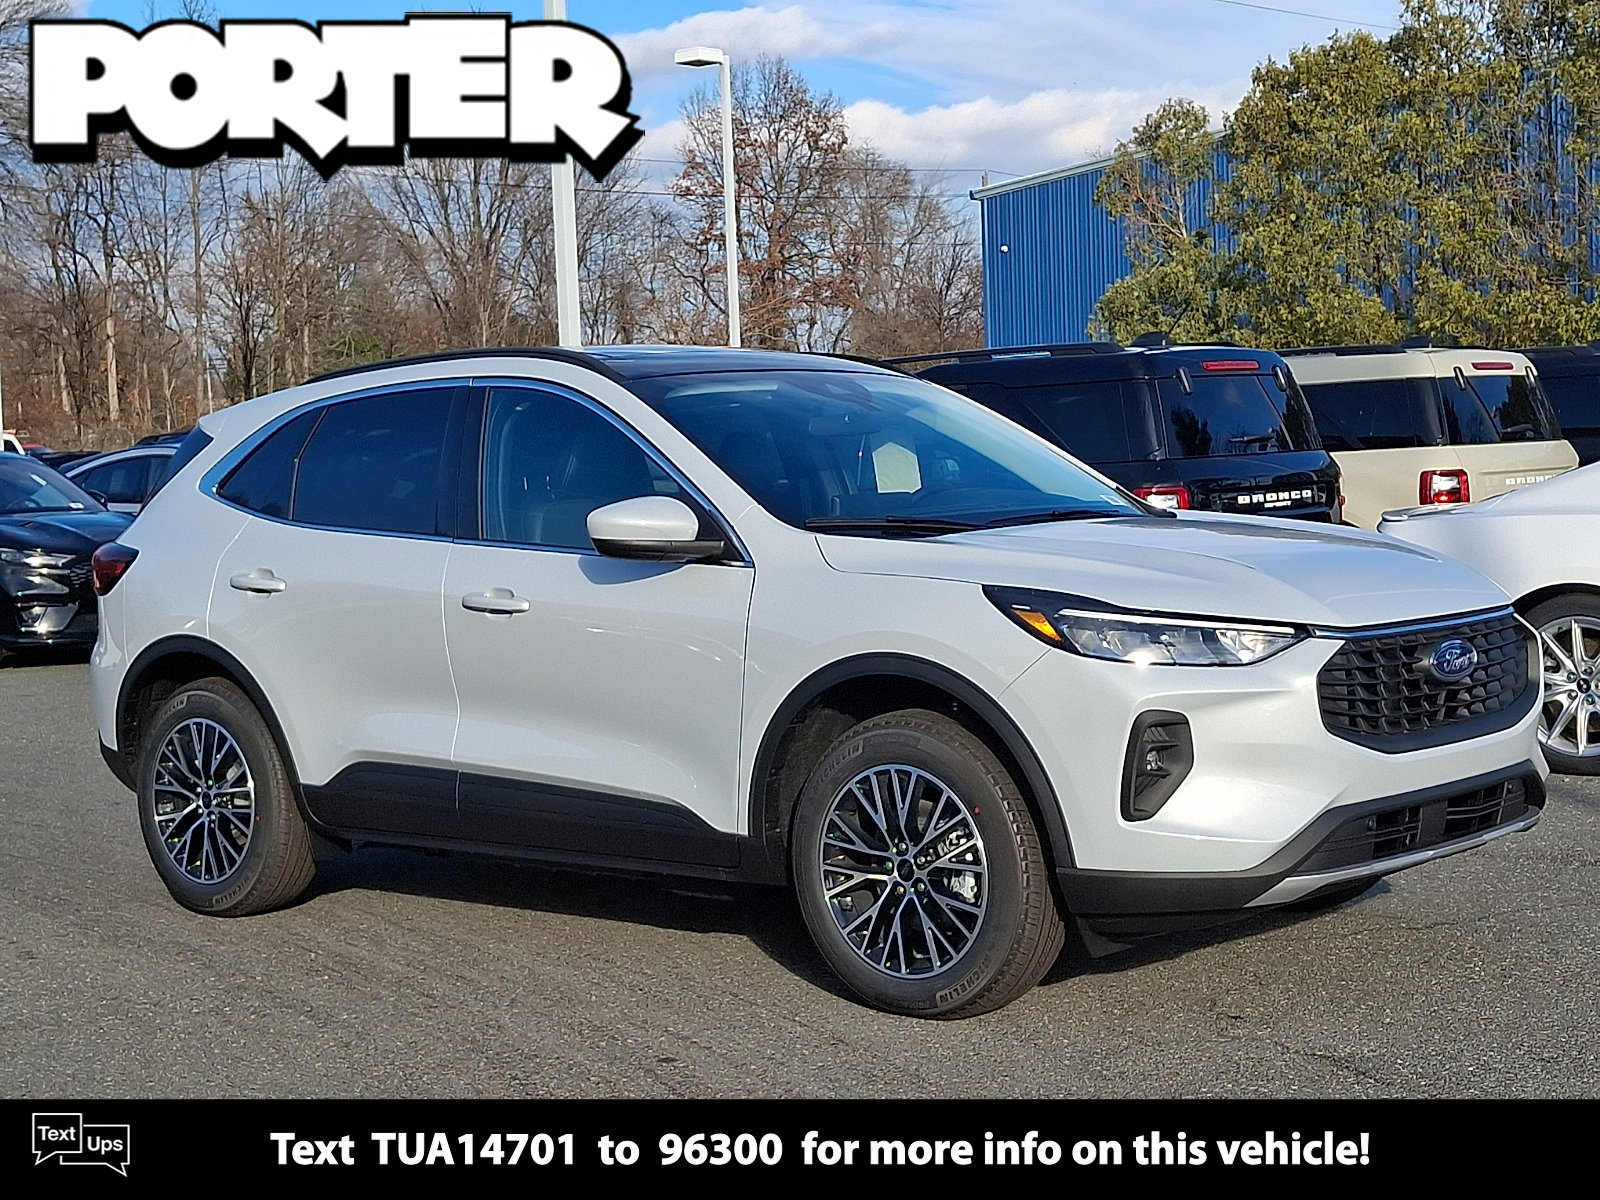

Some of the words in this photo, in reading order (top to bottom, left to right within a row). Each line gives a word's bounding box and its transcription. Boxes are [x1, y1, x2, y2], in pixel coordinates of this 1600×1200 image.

[1505, 474, 1556, 486] BRON
[1237, 489, 1312, 505] BRONCO
[1443, 648, 1471, 672] Ford
